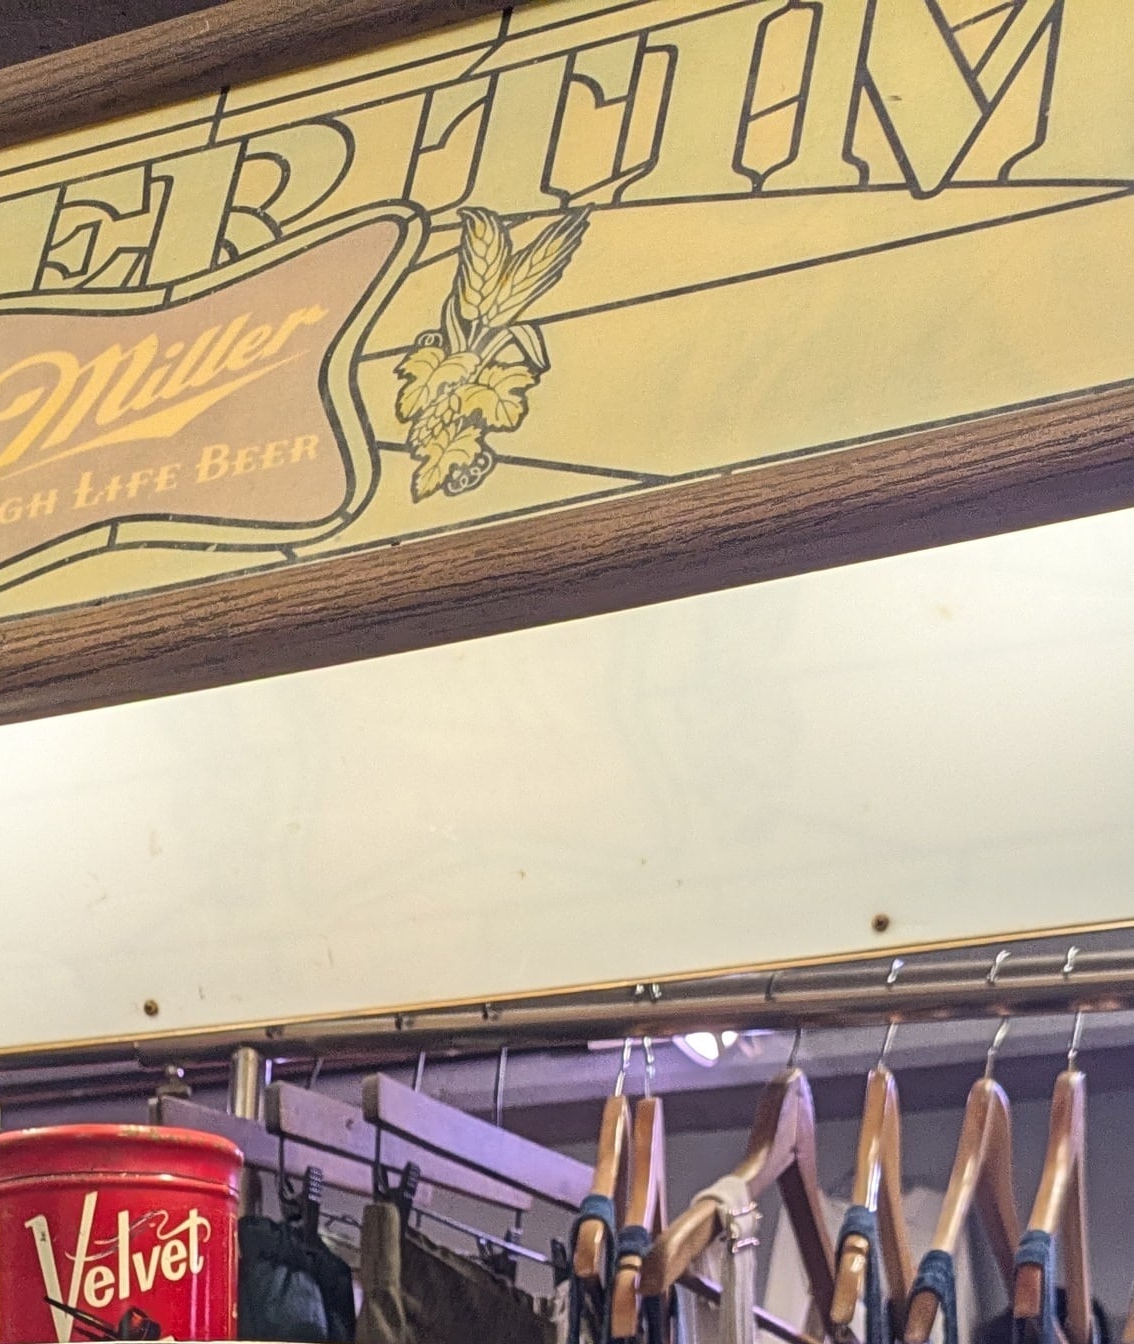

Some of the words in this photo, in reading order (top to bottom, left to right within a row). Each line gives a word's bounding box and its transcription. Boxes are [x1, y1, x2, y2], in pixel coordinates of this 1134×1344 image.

[73, 463, 181, 510] LIFE
[196, 434, 320, 484] BEER
[24, 1191, 212, 1343] Velvet
